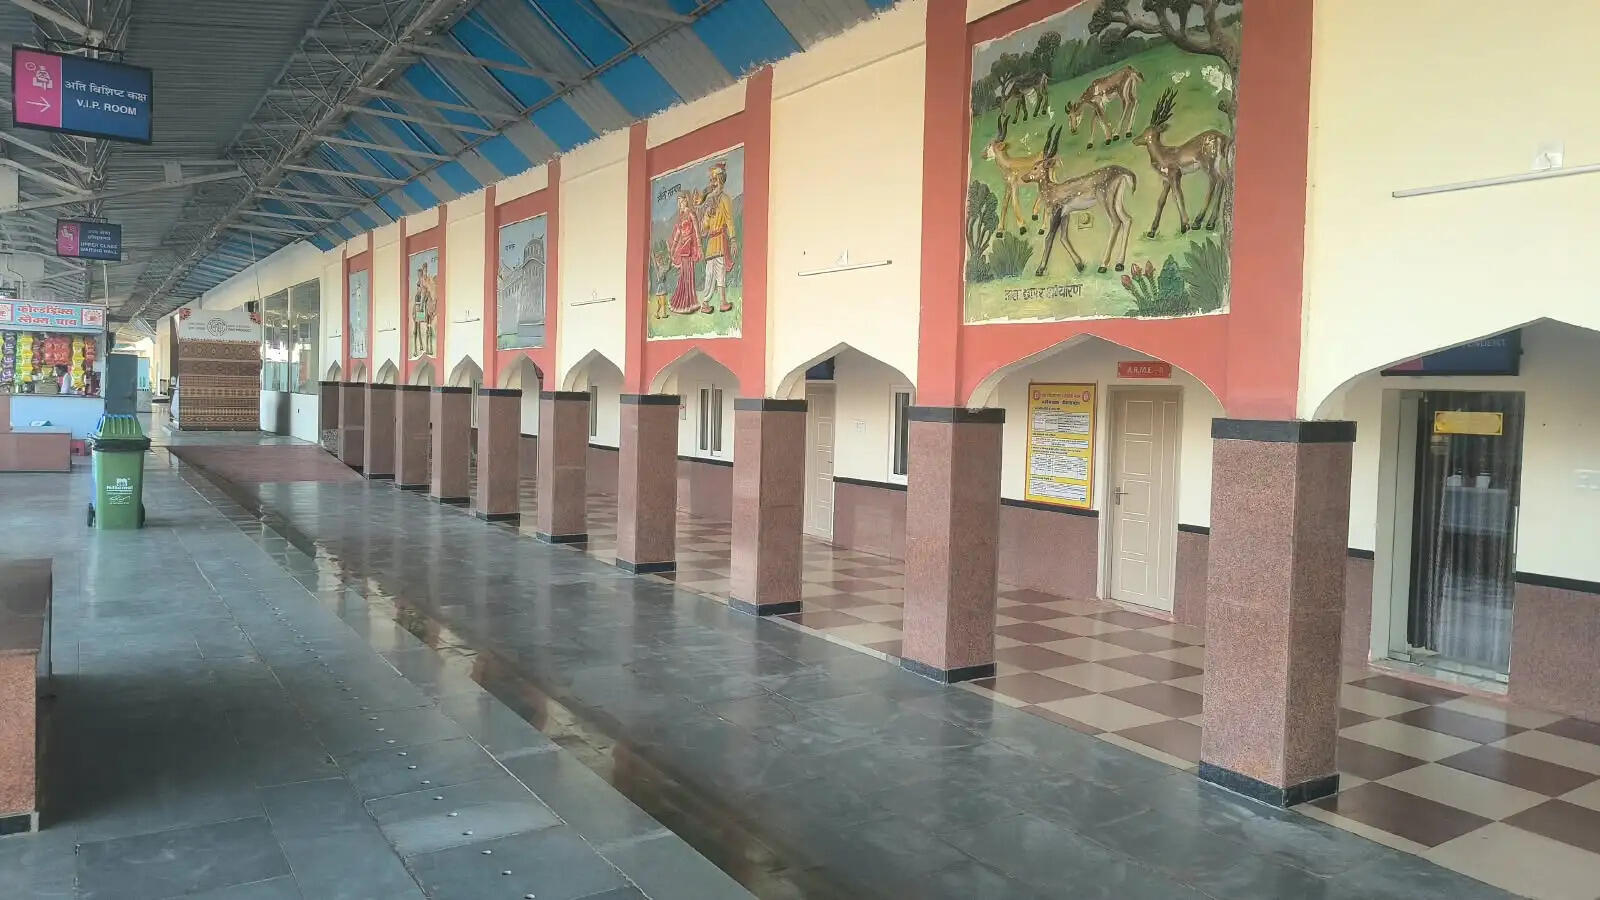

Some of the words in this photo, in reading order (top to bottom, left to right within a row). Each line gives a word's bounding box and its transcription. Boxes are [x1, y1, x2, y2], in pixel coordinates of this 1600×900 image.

[65, 80, 86, 92] अति
[89, 83, 125, 98] विशिष्ट
[127, 91, 148, 103] कक्ष
[76, 99, 101, 109] V.I.P.
[104, 103, 137, 116] ROOM
